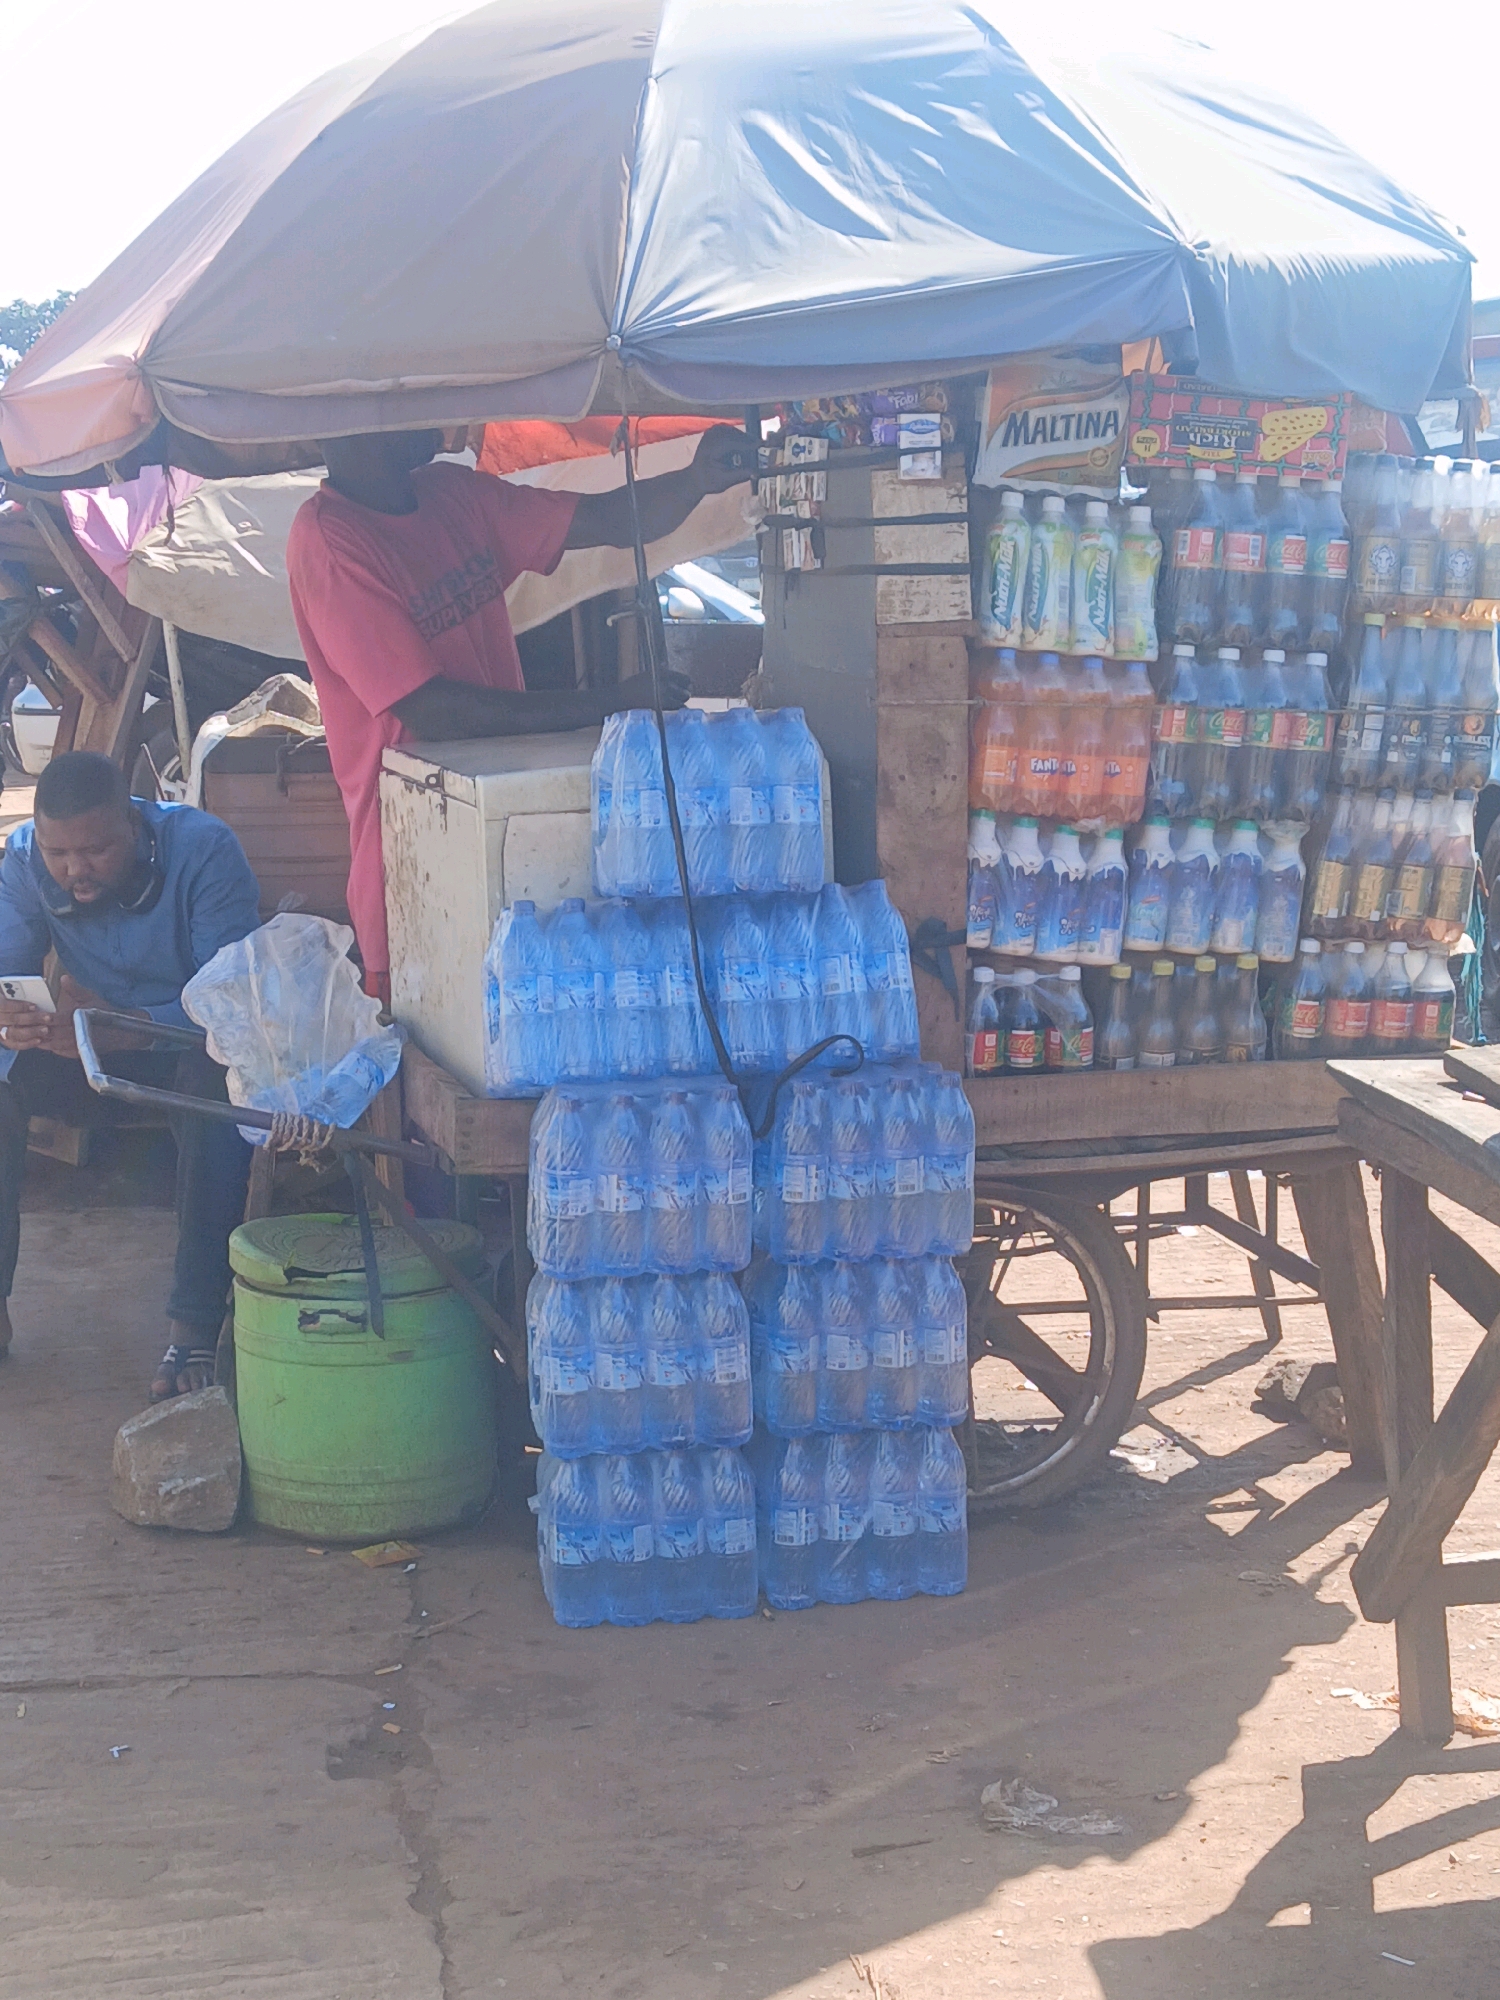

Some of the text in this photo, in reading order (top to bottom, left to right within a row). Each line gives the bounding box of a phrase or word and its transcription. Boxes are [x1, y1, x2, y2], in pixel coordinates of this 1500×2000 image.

[1001, 410, 1119, 447] MALTINA
[1187, 432, 1236, 449] Rich
[992, 540, 1016, 622] Nutri-Milk
[1089, 549, 1111, 631] Nutri-Milk
